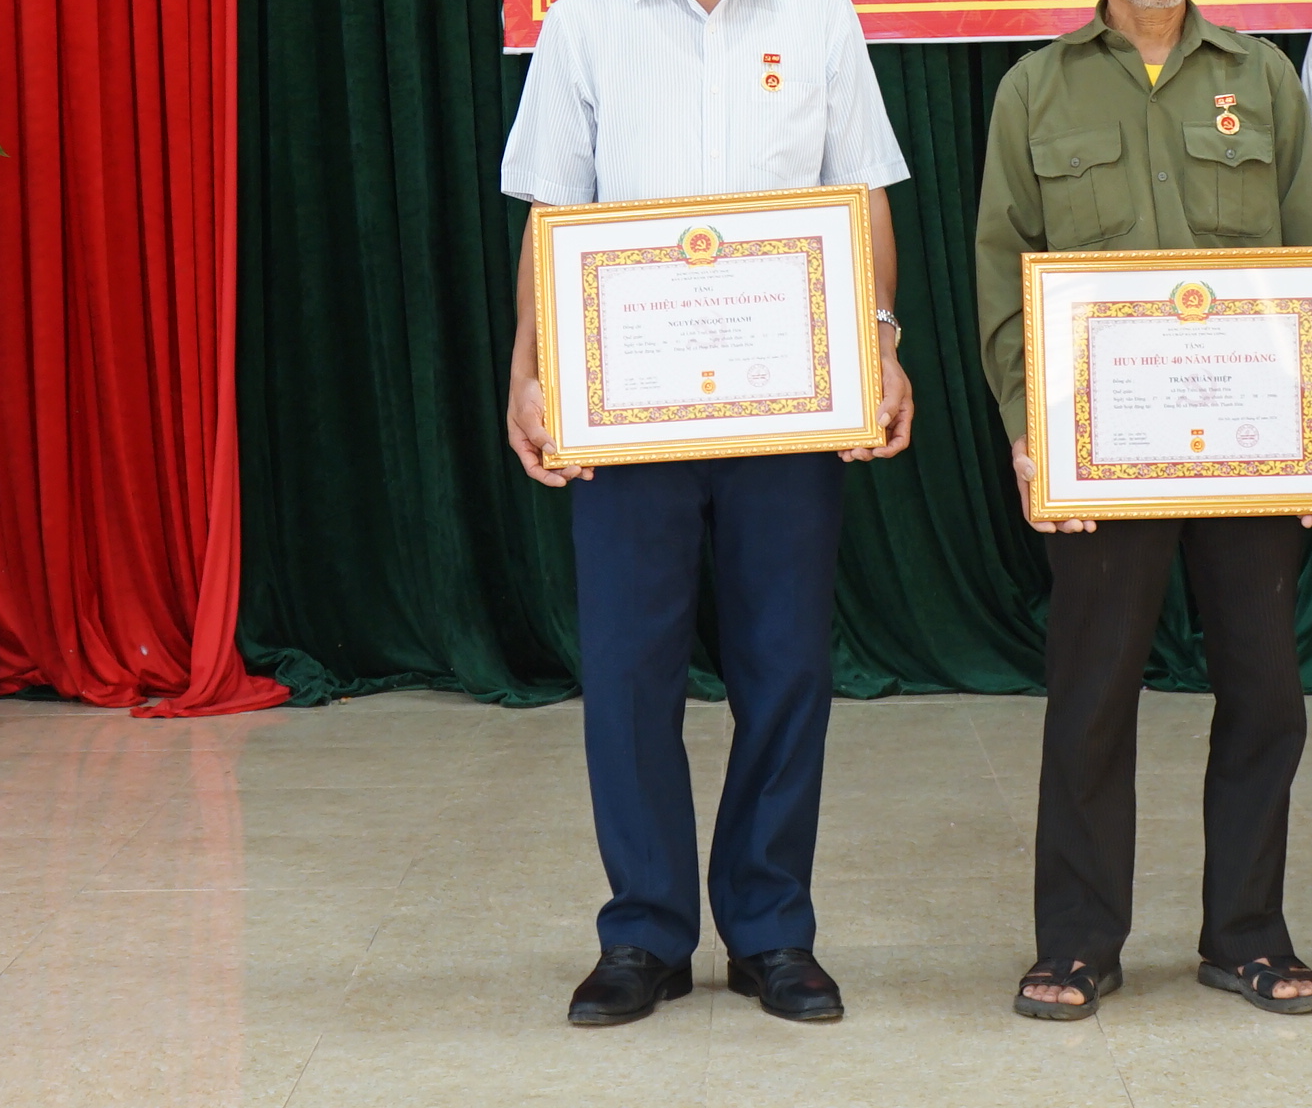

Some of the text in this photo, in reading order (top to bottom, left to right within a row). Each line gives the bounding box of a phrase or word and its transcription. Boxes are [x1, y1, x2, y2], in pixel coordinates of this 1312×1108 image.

[623, 302, 647, 313] HUY
[650, 297, 678, 312] HIỆU
[680, 299, 692, 308] 40
[694, 296, 720, 307] NĂM
[1113, 357, 1138, 367] HUY
[1140, 353, 1169, 368] HIỆU
[1171, 356, 1183, 365] 40
[1184, 353, 1212, 365] NĂM
